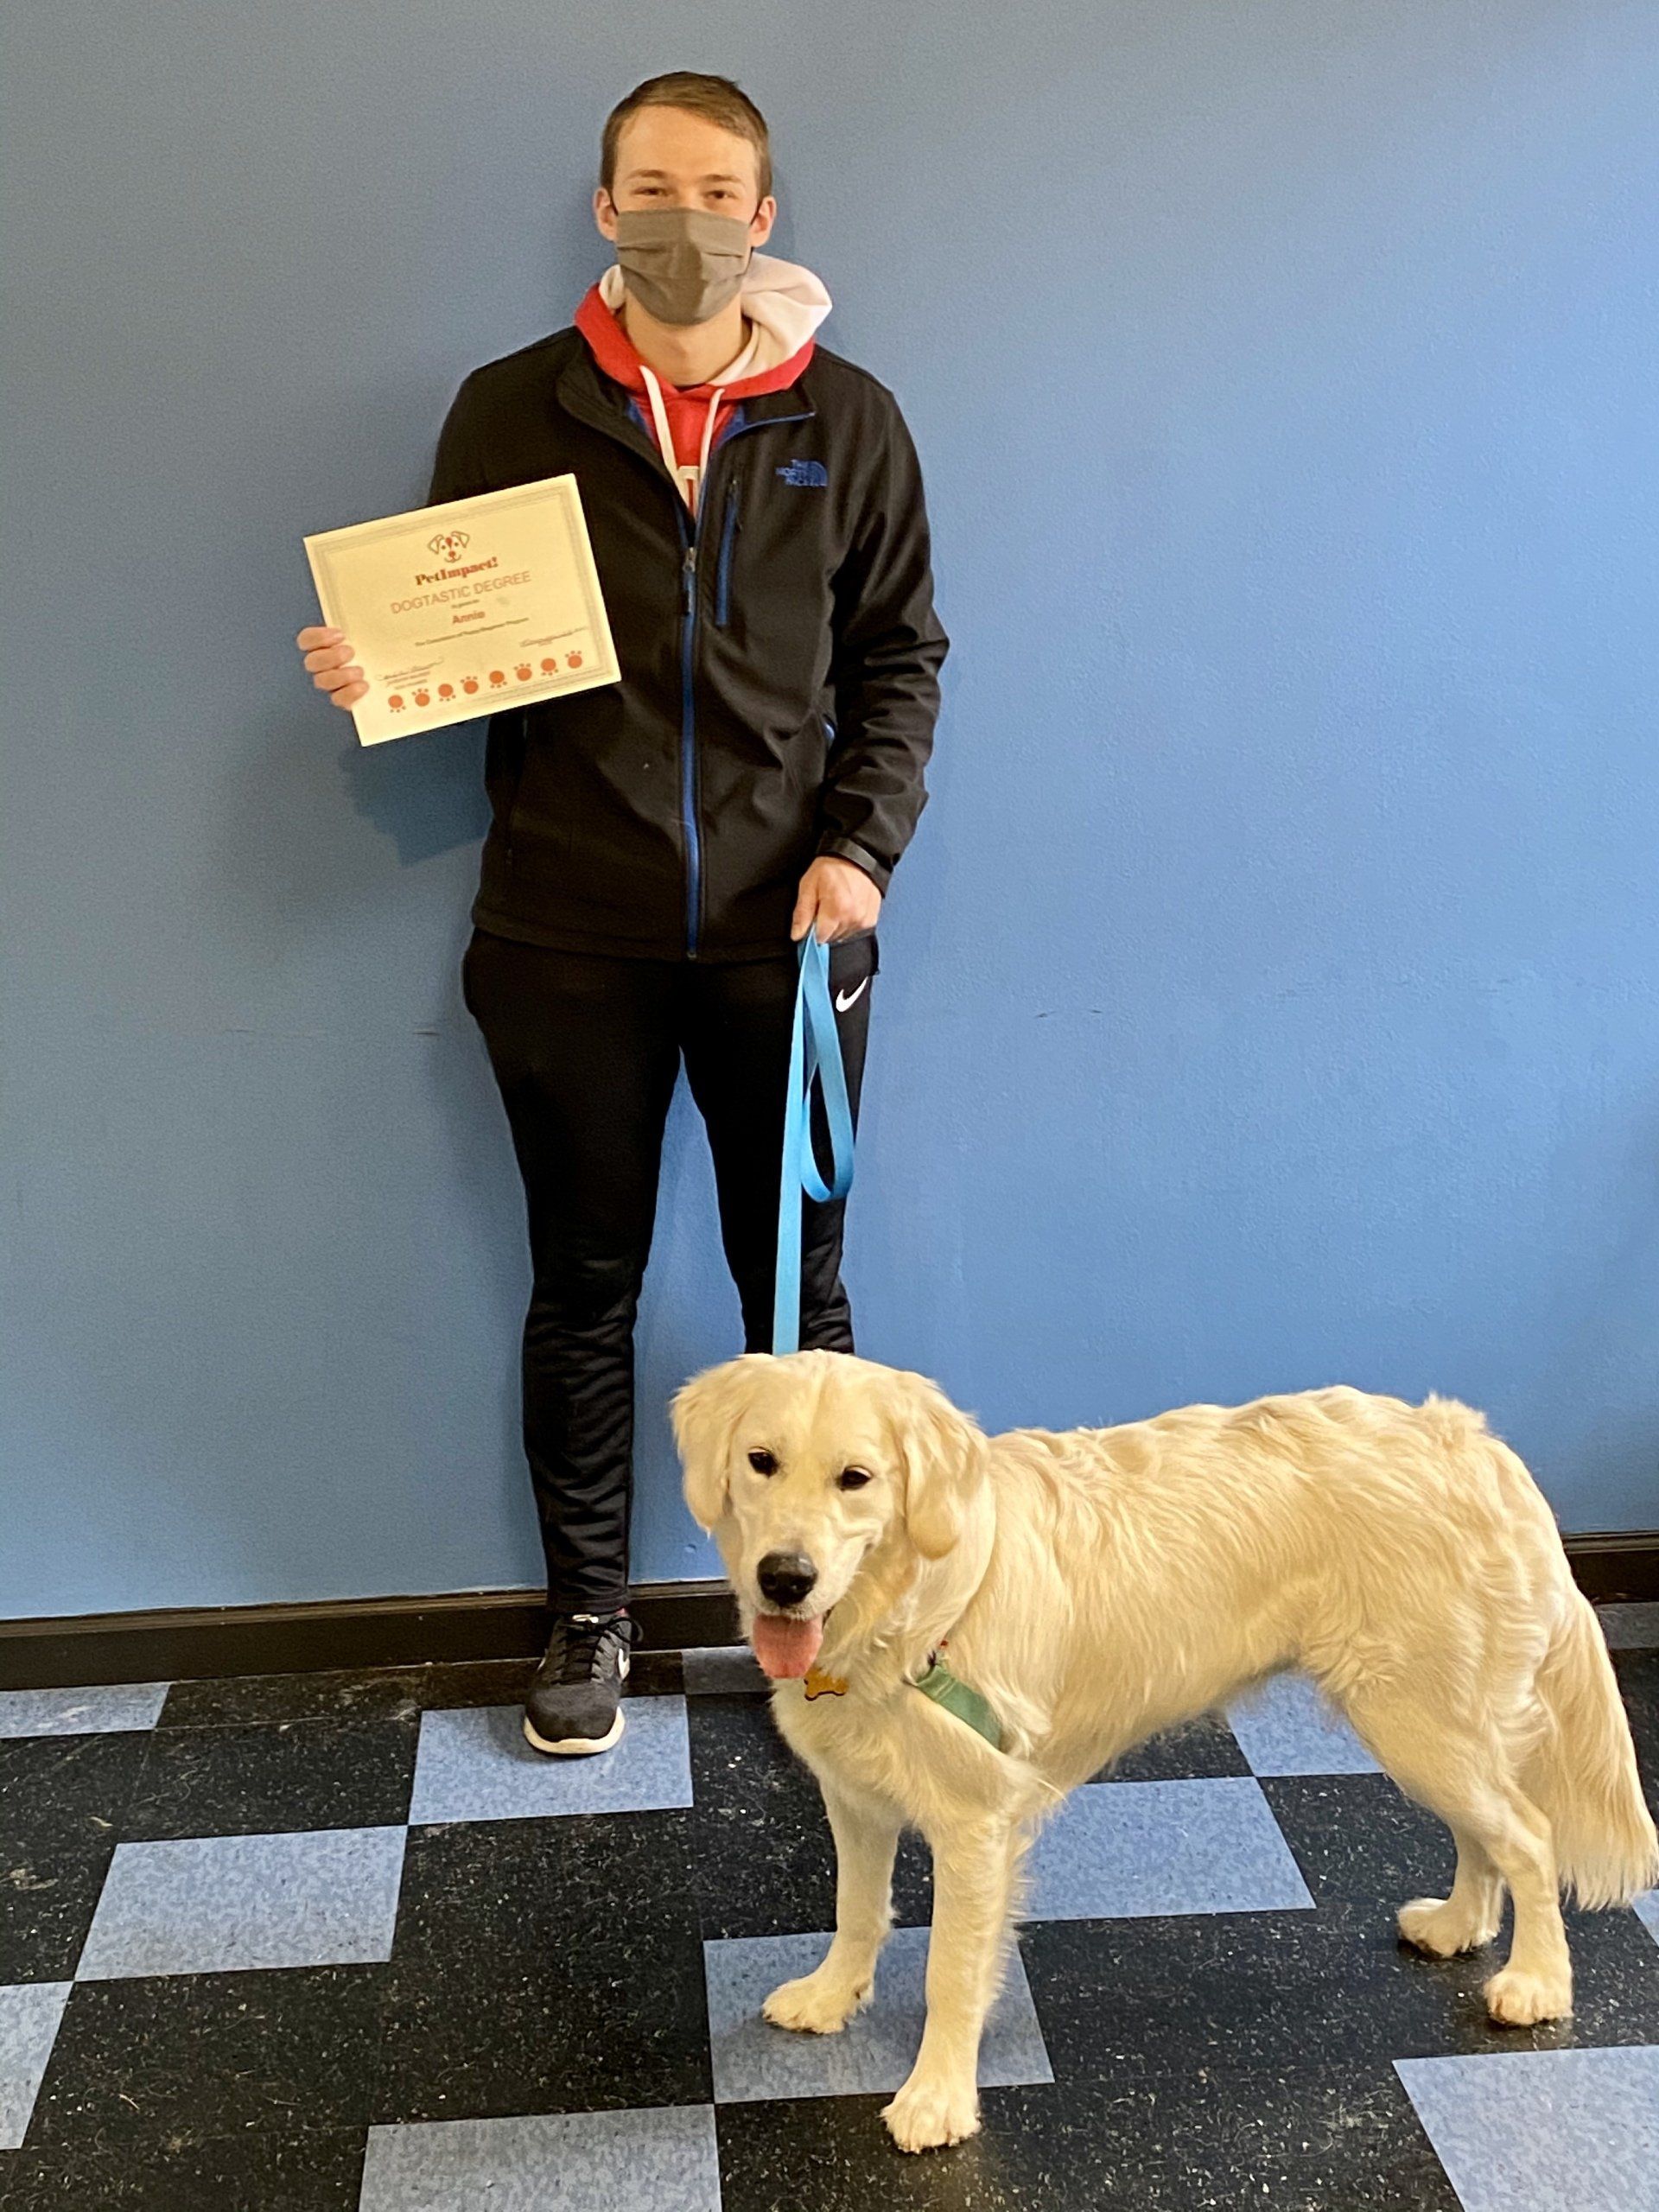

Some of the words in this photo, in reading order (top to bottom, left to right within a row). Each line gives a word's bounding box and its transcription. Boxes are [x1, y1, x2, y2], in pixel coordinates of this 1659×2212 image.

[415, 556, 499, 586] PetImpact!
[391, 586, 471, 614] DOGTASTIC
[473, 570, 531, 595] DEGREE
[452, 610, 486, 625] Annie
